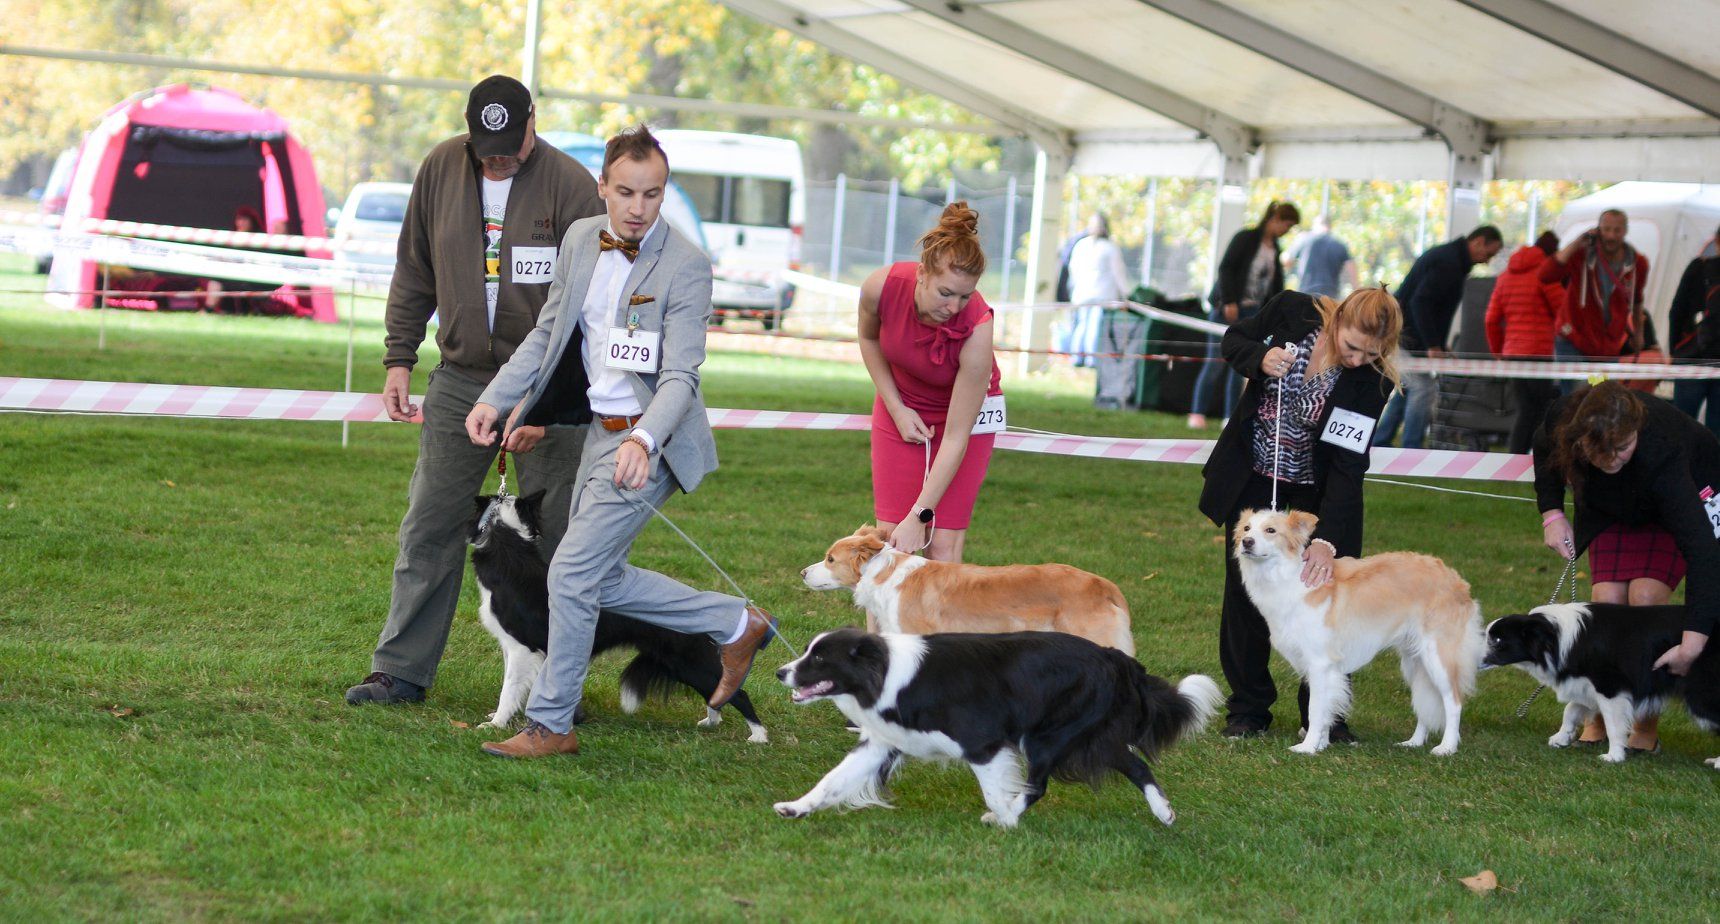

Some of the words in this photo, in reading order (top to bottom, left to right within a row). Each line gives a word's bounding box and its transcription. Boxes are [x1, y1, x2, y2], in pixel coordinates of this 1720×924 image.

[516, 261, 552, 275] 0272
[611, 343, 650, 362] 0279
[979, 410, 1004, 425] 273
[1329, 421, 1364, 443] 0274
